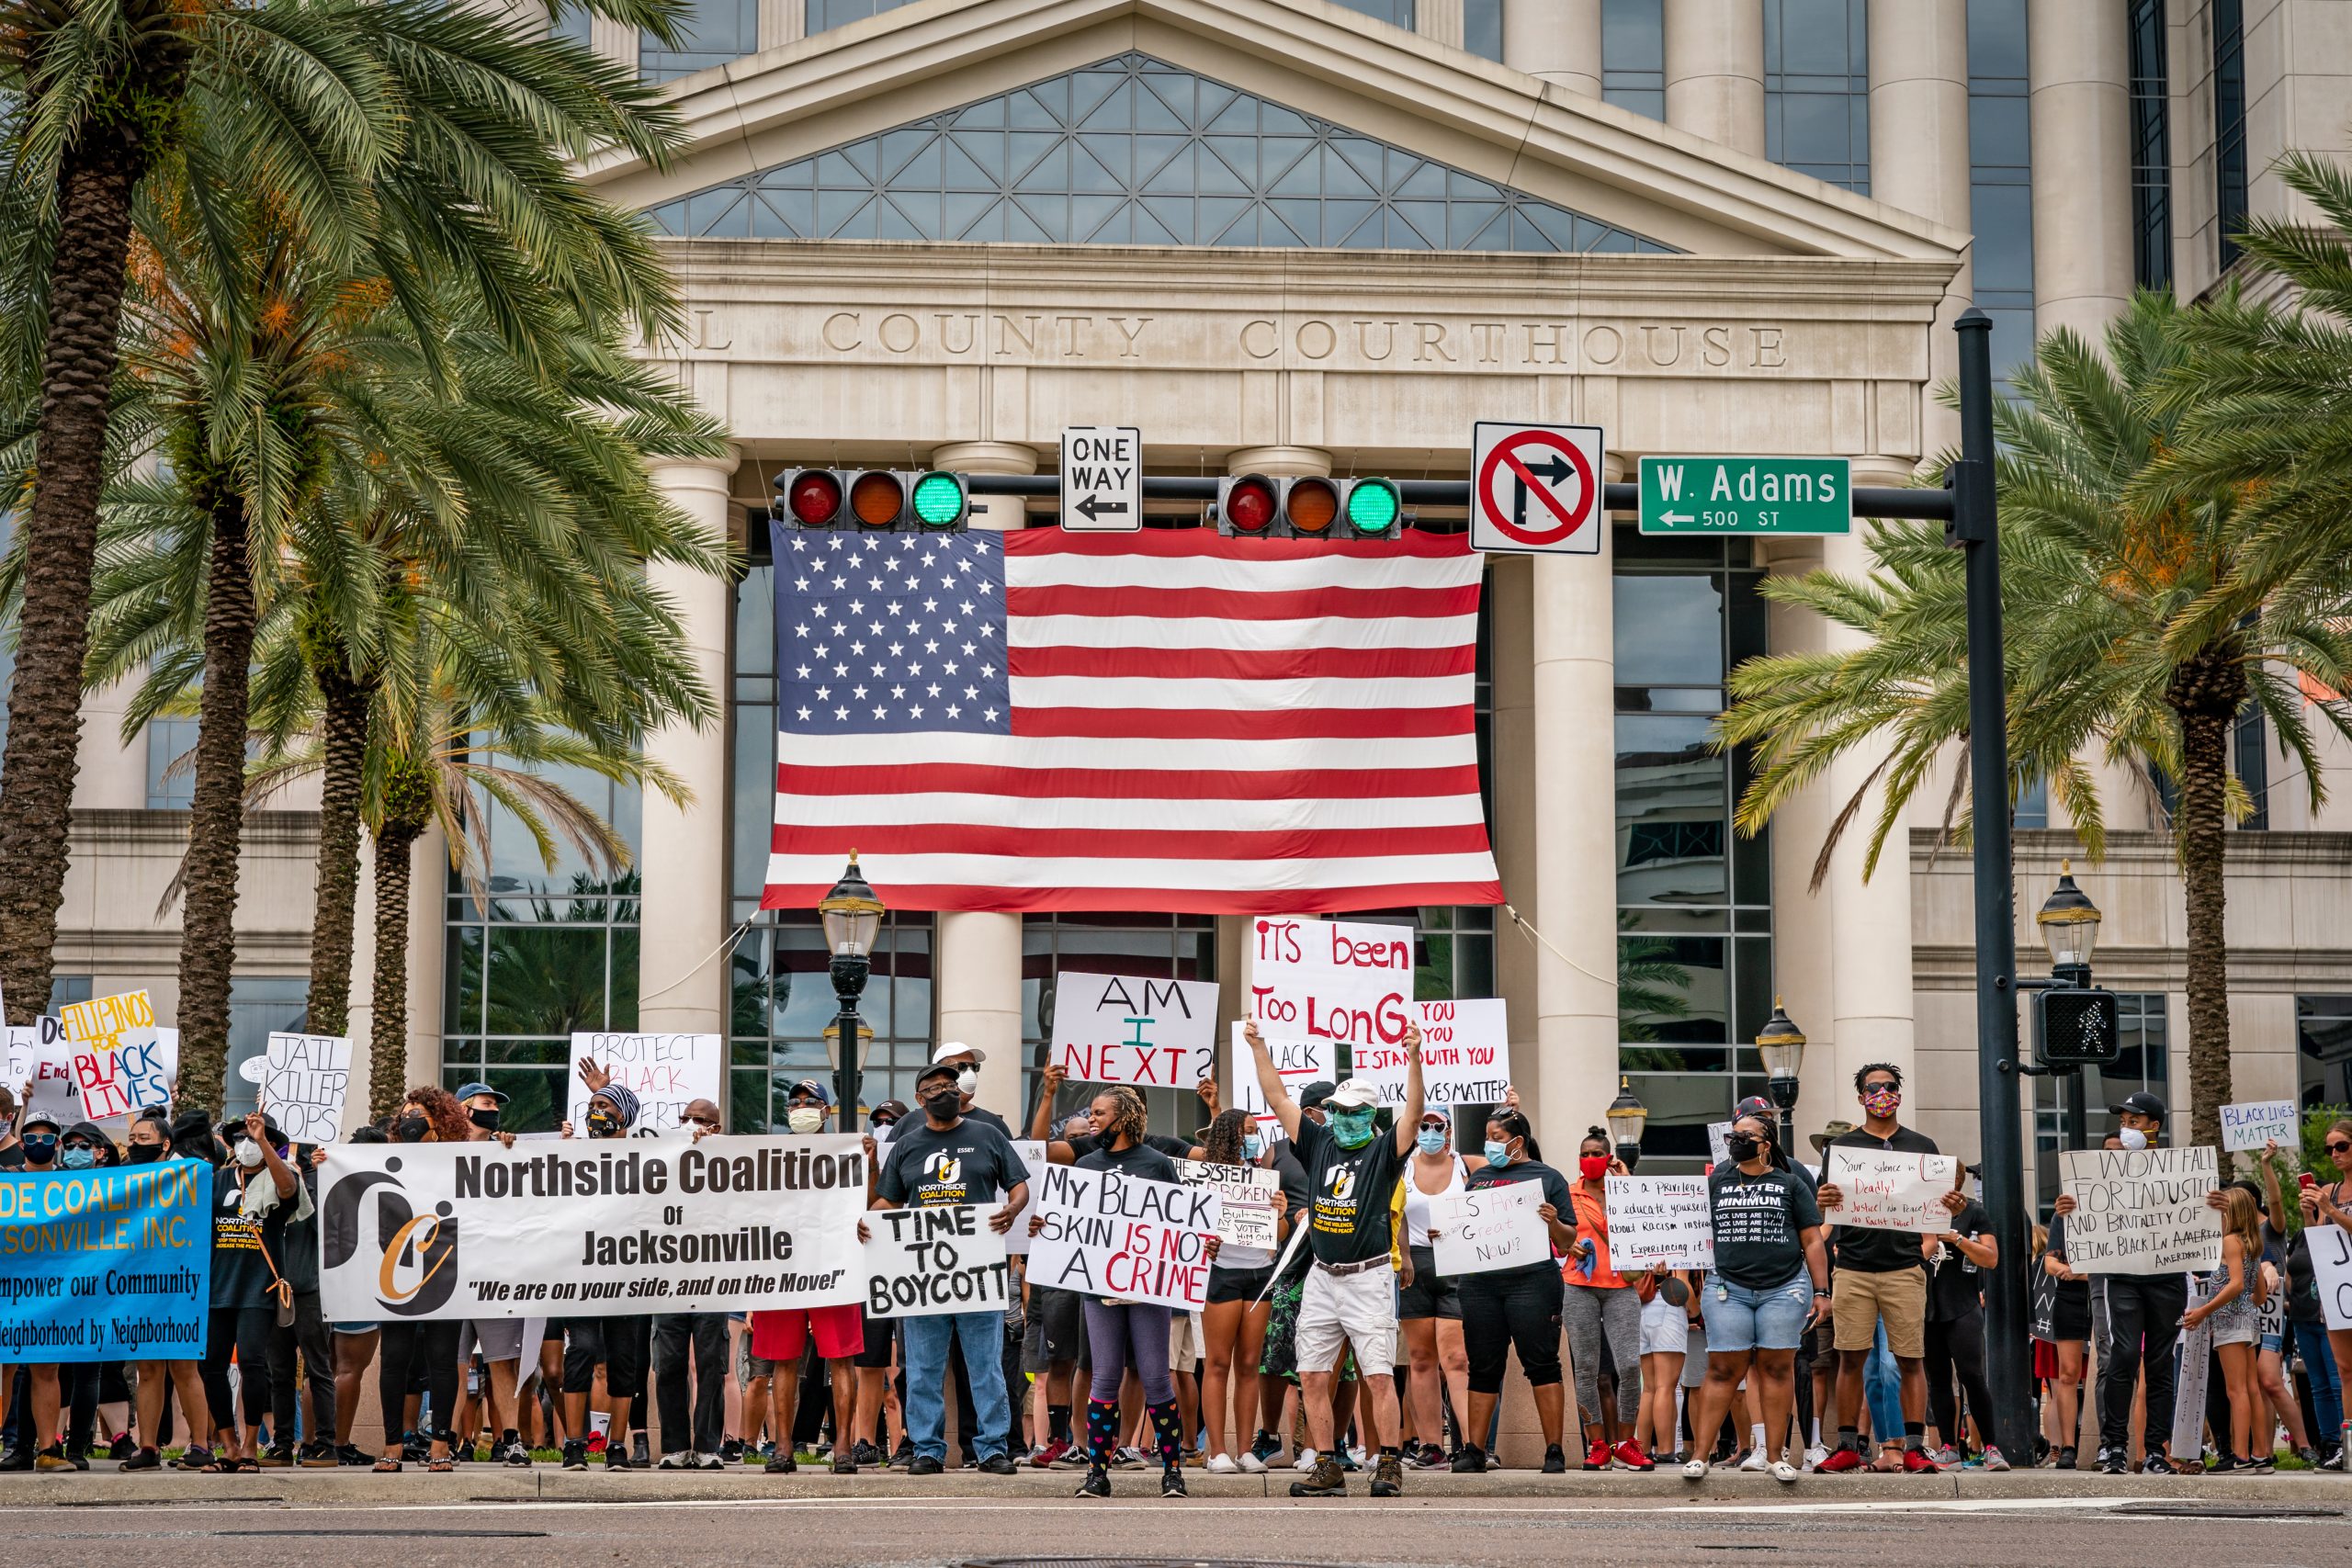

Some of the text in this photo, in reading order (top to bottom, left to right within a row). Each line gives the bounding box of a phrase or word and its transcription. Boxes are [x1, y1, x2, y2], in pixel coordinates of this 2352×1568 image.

[822, 313, 1154, 357] COUNTY
[1239, 320, 1786, 367] COURTHOUSE
[1073, 438, 1130, 461] ONE
[1072, 467, 1131, 490] WAY
[1710, 465, 1836, 502] Adams
[1702, 511, 1780, 526] 500 ST
[1332, 923, 1408, 970] been
[1096, 976, 1192, 1019] AM
[1421, 1002, 1455, 1021] YOU
[60, 992, 155, 1043] FILIPINOS
[91, 1033, 122, 1054] FOR
[1123, 1018, 1155, 1046] I
[1422, 1027, 1453, 1043] YOU
[269, 1036, 349, 1071] JAIL
[592, 1033, 704, 1062] PROTECT
[1270, 1044, 1319, 1070] LACK
[1355, 1051, 1368, 1068] I
[1426, 1048, 1460, 1066] WITH
[1467, 1046, 1494, 1066] YOU
[74, 1040, 163, 1089] BLACK
[84, 1075, 169, 1120] LIVES
[264, 1069, 347, 1106] KILLER
[1453, 1079, 1508, 1102] MATTER
[266, 1102, 336, 1142] COPS
[2223, 1105, 2294, 1126] BLACK LIVES
[2233, 1122, 2290, 1145] MATTER
[456, 1148, 864, 1199] Northside Coalition
[1176, 1158, 1192, 1178] HE
[1838, 1154, 1866, 1173] Your
[2063, 1152, 2092, 1181] I
[2182, 1147, 2215, 1172] FALL
[43, 1164, 198, 1217] COALITION
[918, 1183, 967, 1192] NORTHSIDE
[920, 1190, 966, 1200] COALITION
[1098, 1172, 1213, 1230] BLACK
[1316, 1195, 1357, 1207] NORTHSIDE
[1642, 1182, 1649, 1192] a
[1721, 1183, 1785, 1194] MATTER
[1855, 1178, 1894, 1200] Deadly!
[2075, 1176, 2219, 1213] FOR INJUSTICE
[663, 1205, 683, 1225] Of
[1315, 1204, 1356, 1215] COALITION
[1608, 1205, 1616, 1214] to
[1623, 1204, 1665, 1215] educate
[1717, 1196, 1781, 1207] MINIMUM
[0, 1215, 192, 1254] SONVILLE, INC.
[882, 1205, 976, 1242] TIME
[1234, 1224, 1261, 1233] VOTE
[1462, 1219, 1514, 1239] Great
[1609, 1222, 1636, 1234] about
[2066, 1205, 2203, 1238] AND BRUTALITY OF
[582, 1225, 793, 1266] Jacksonville
[1038, 1212, 1216, 1267] SKIN IS NOT
[1611, 1243, 1619, 1258] of
[2067, 1240, 2113, 1265] BEING
[2117, 1235, 2148, 1256] BLACK
[2149, 1232, 2167, 1250] IN
[904, 1240, 958, 1273] TO
[71, 1276, 98, 1297] our
[106, 1265, 201, 1301] Community
[514, 1284, 548, 1301] are
[551, 1283, 576, 1300] on
[580, 1280, 625, 1301] your
[628, 1277, 673, 1299] side,
[676, 1276, 715, 1296] and
[717, 1278, 741, 1294] on
[744, 1273, 775, 1293] the
[869, 1262, 1007, 1314] BOYCOTT
[1057, 1247, 1208, 1304] A CRIME
[91, 1317, 106, 1351] by
[111, 1315, 199, 1351] Neighborhood
